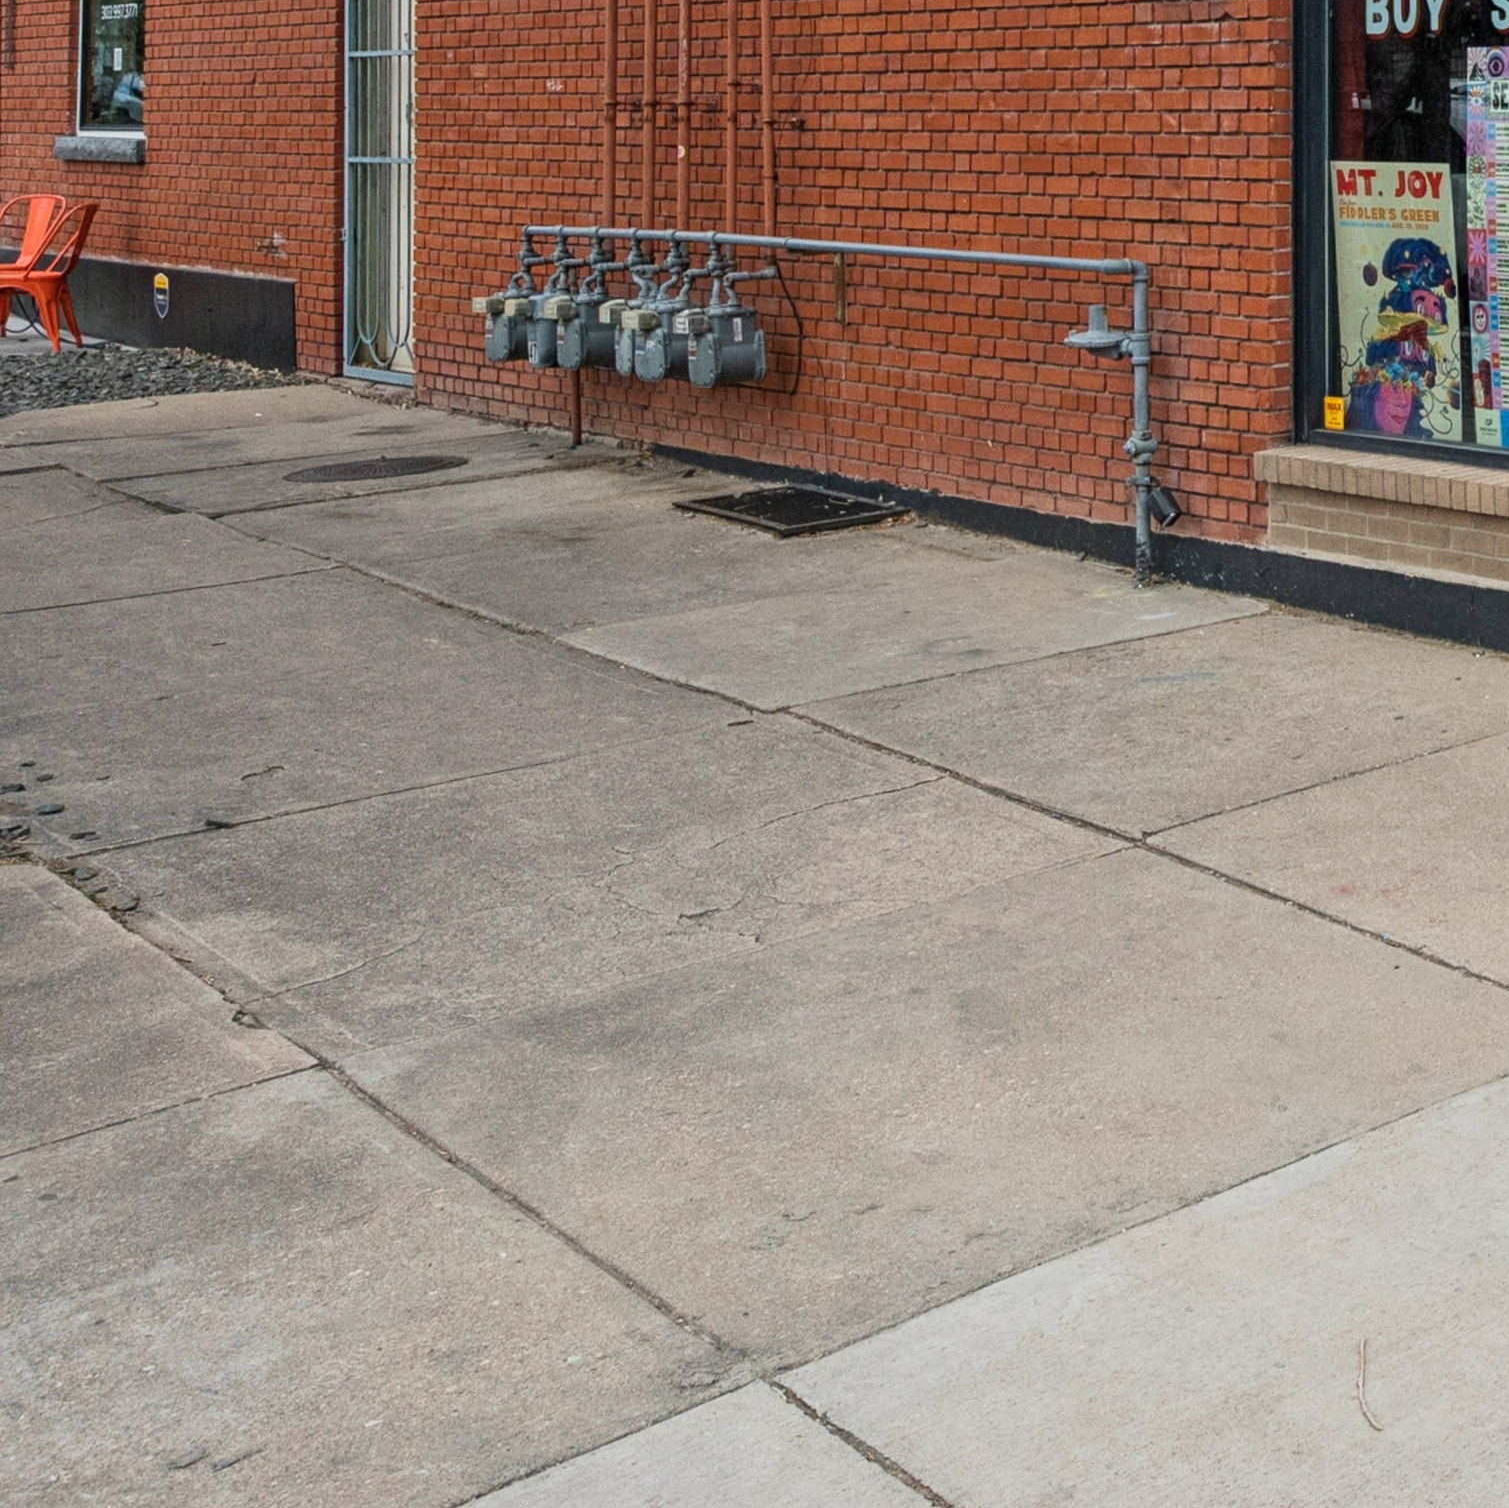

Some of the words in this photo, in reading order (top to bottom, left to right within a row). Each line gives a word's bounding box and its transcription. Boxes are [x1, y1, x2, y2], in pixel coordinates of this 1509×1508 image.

[1336, 169, 1383, 197] MT.
[1395, 170, 1443, 199] JOY
[1339, 206, 1396, 221] FIDDLER'S
[1401, 208, 1440, 222] GREEN
